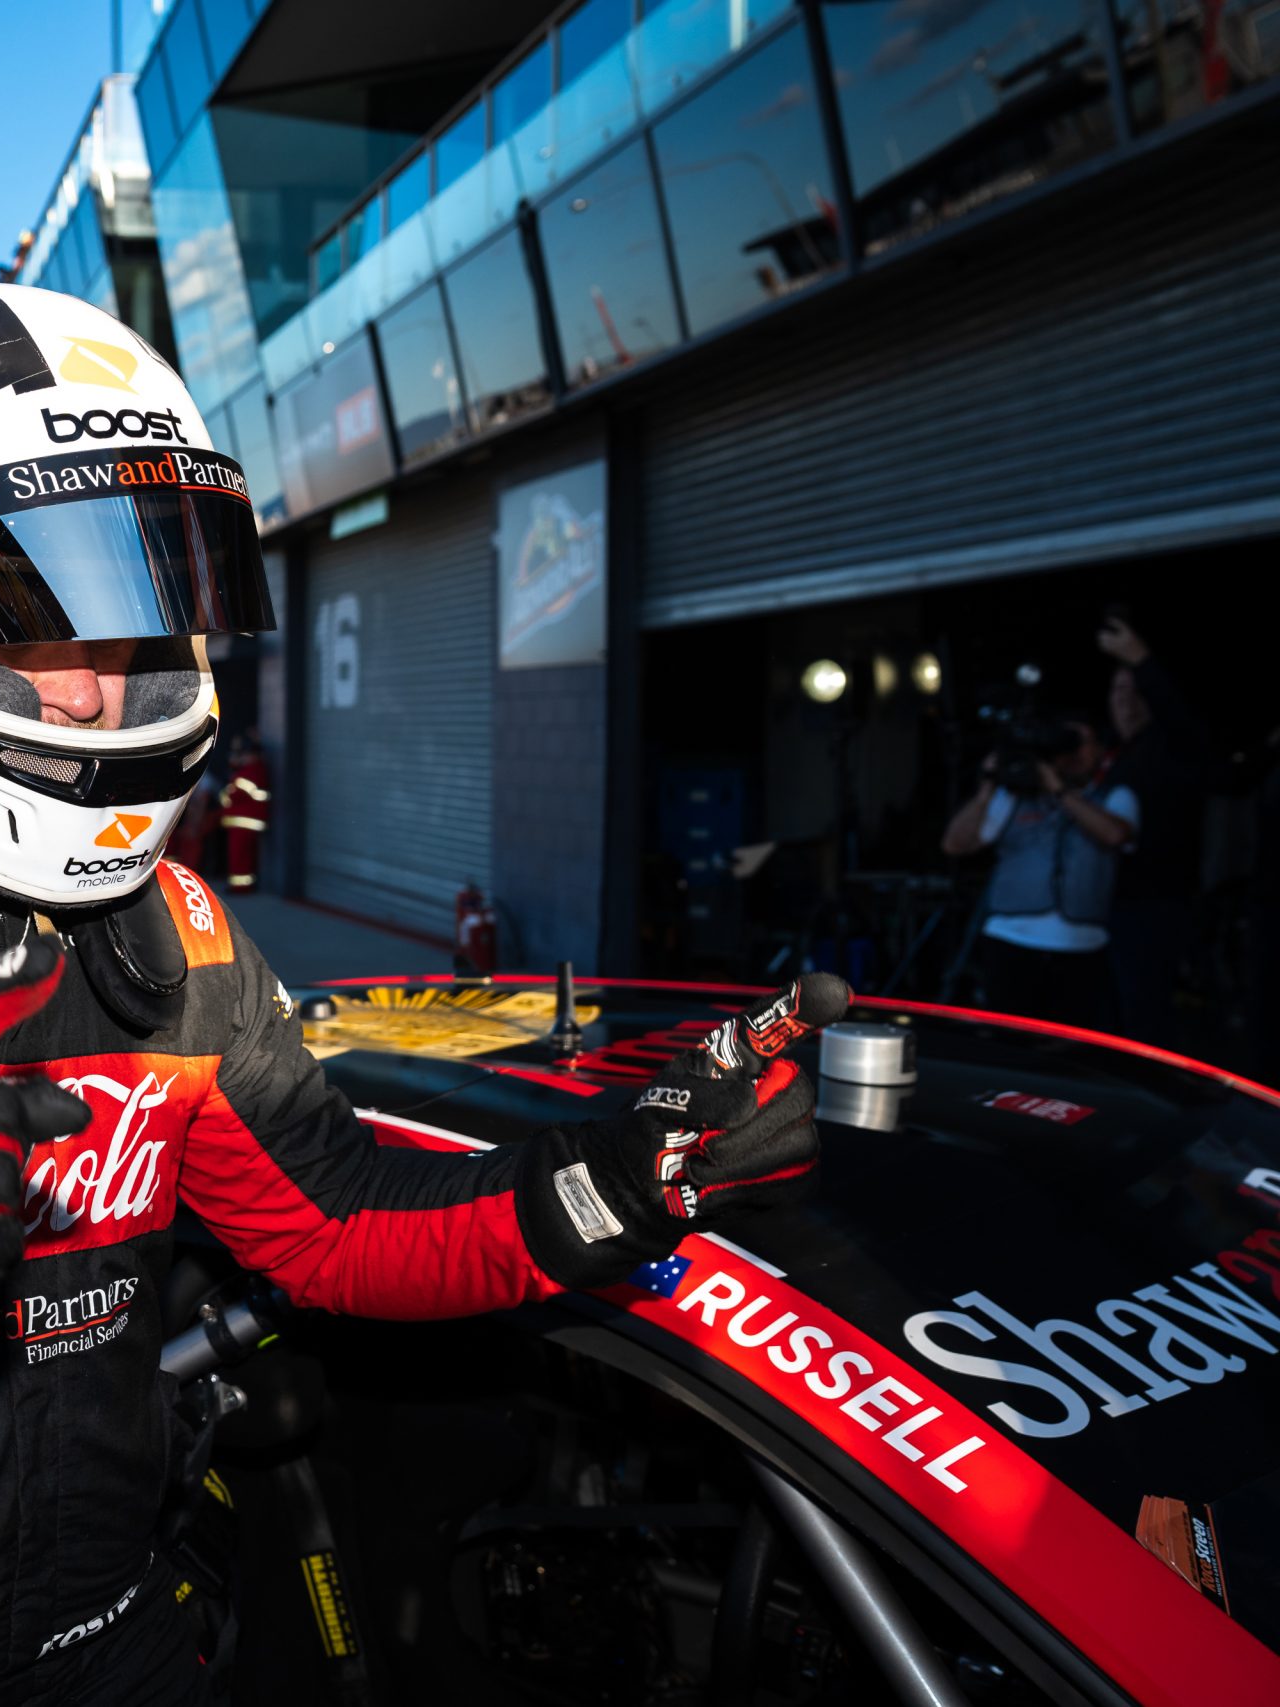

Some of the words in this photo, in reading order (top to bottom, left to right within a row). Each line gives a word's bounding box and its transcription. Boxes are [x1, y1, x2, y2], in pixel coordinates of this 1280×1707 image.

[40, 407, 188, 445] boost
[63, 849, 151, 877] boost
[76, 873, 127, 889] mobile
[25, 1329, 95, 1365] Financial
[96, 1311, 130, 1345] Services
[677, 1271, 987, 1494] RUSSELL
